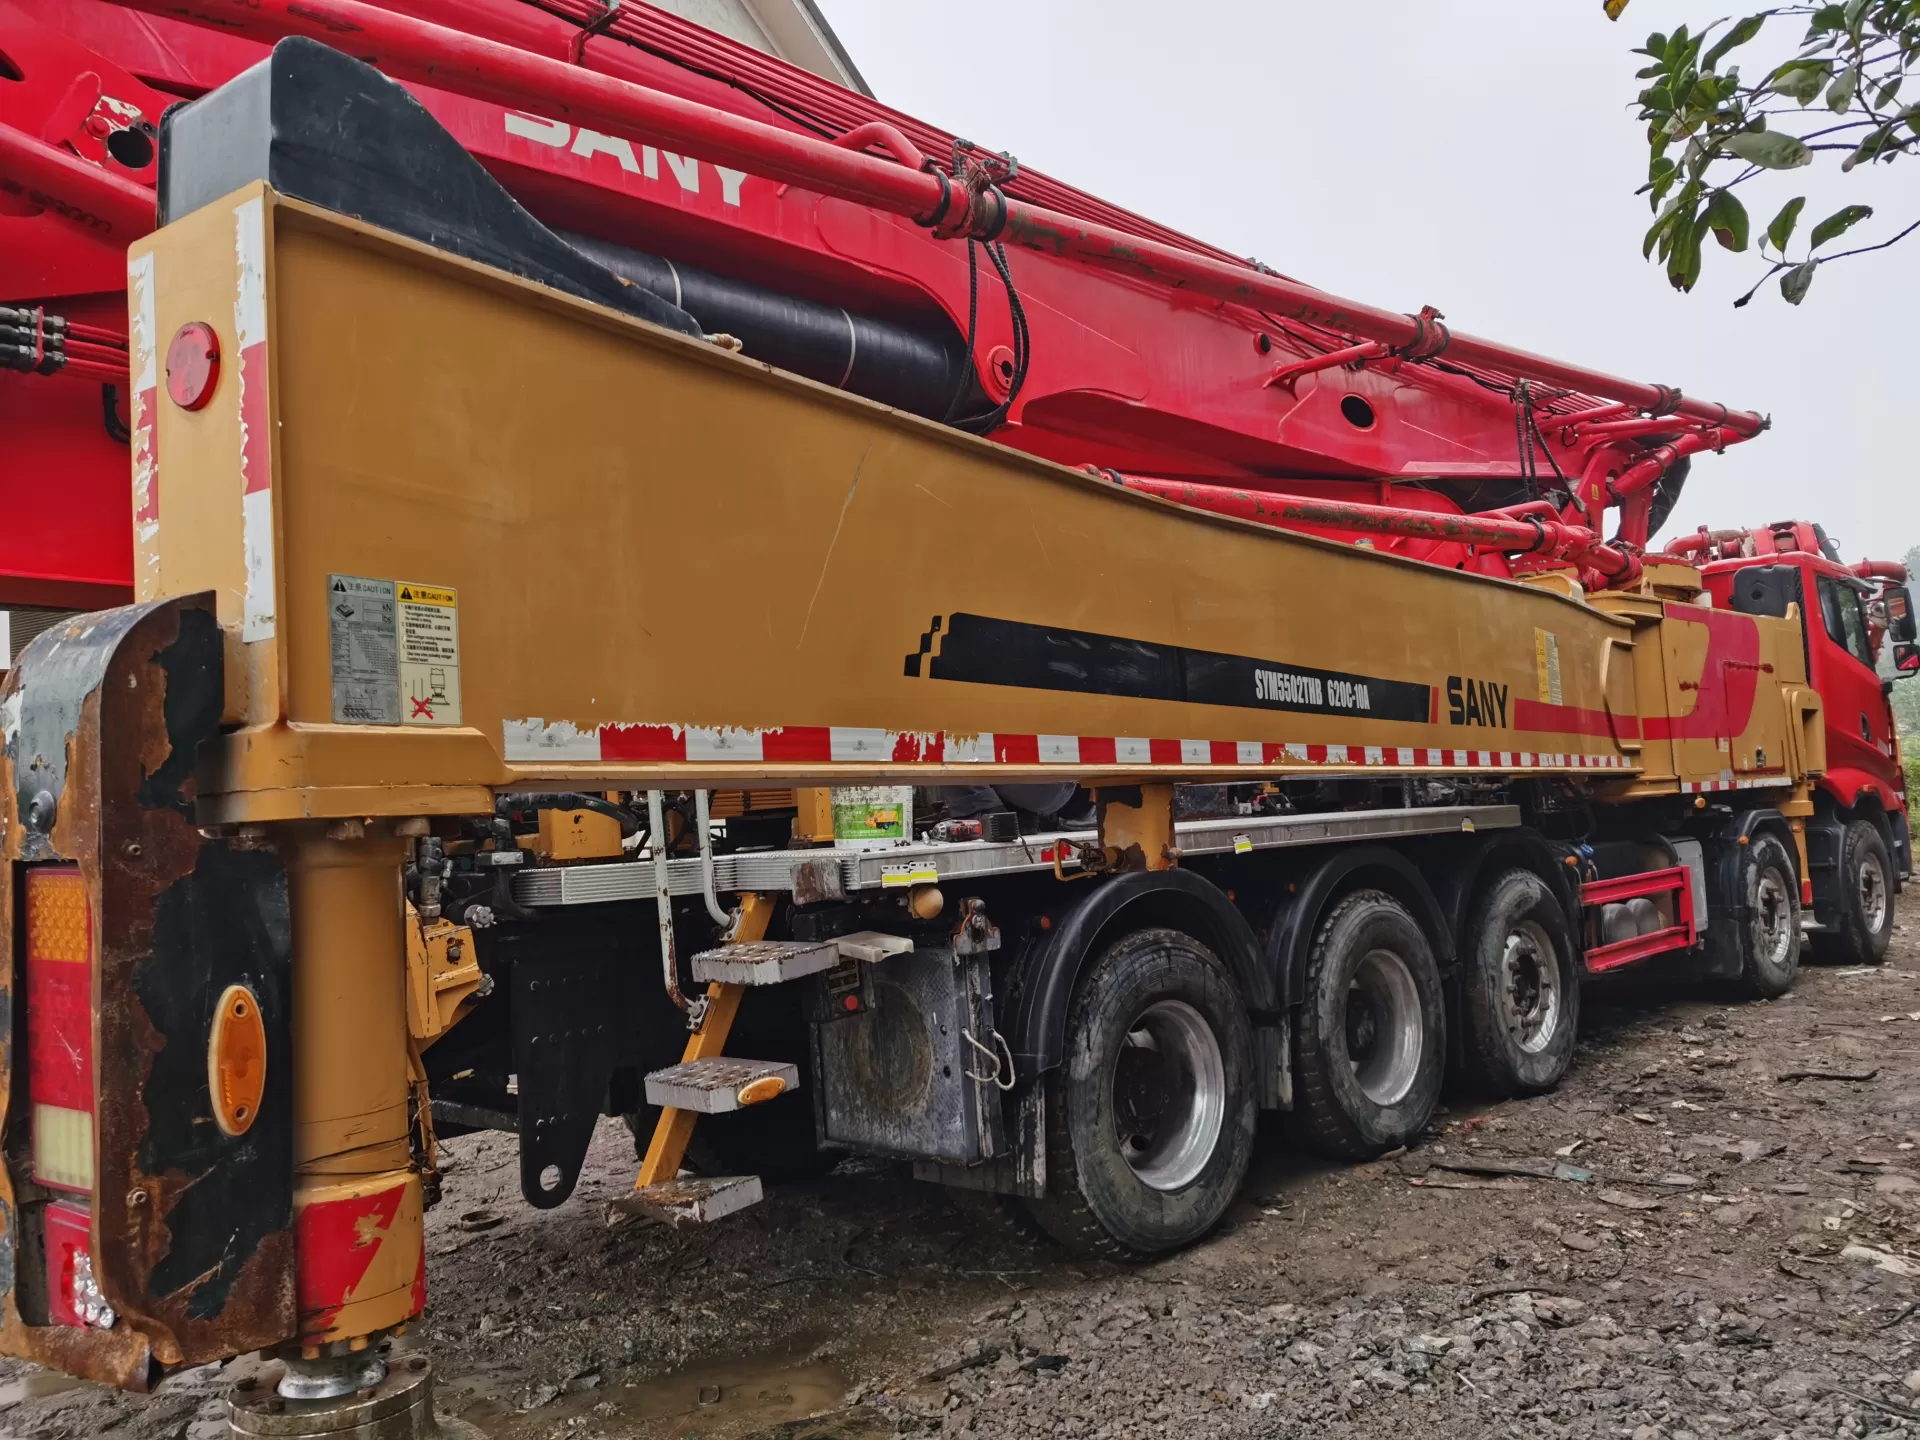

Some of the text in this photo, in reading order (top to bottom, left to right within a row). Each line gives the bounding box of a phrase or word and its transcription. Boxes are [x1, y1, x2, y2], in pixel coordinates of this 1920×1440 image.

[362, 584, 391, 595] CAUTION
[428, 592, 453, 602] CAUTION
[1254, 668, 1371, 710] SYM5502THB 620C-10A
[1446, 675, 1509, 729] SANY
